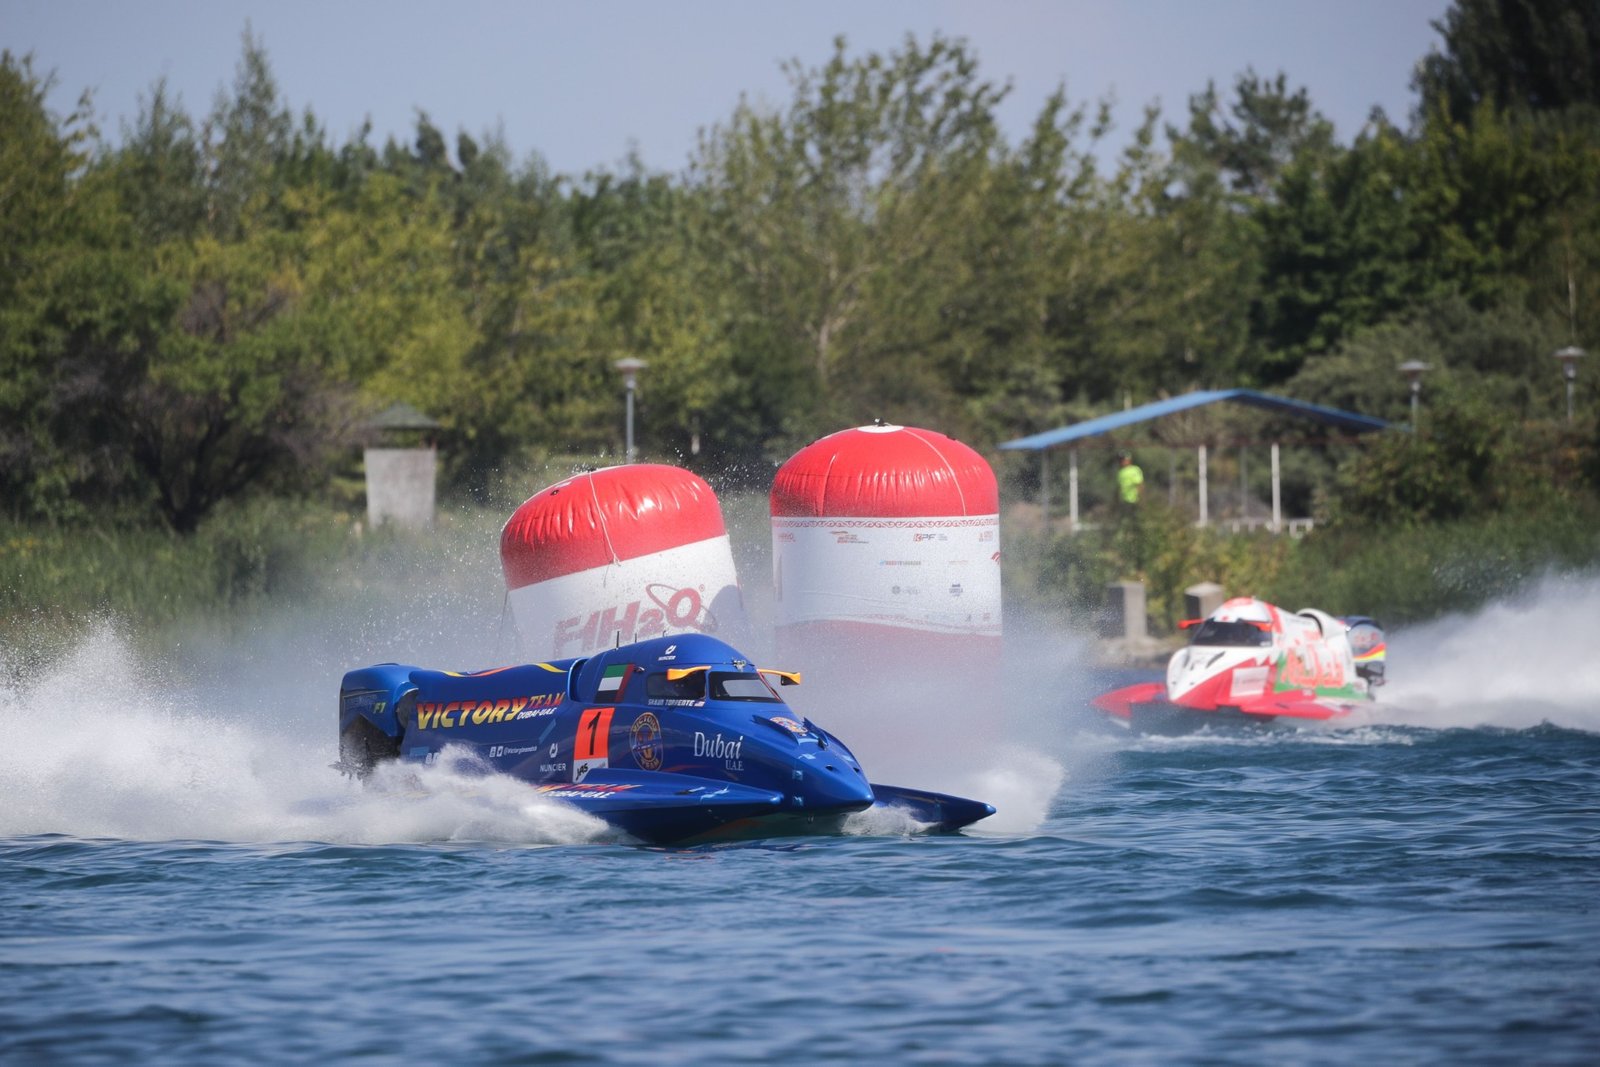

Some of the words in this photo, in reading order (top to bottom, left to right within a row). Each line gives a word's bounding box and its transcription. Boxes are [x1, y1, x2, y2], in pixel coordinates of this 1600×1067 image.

[416, 697, 528, 730] VICTORY
[528, 691, 566, 708] TEAM
[587, 711, 602, 756] 1
[693, 731, 744, 759] Dubai
[539, 762, 567, 773] NUNCIER
